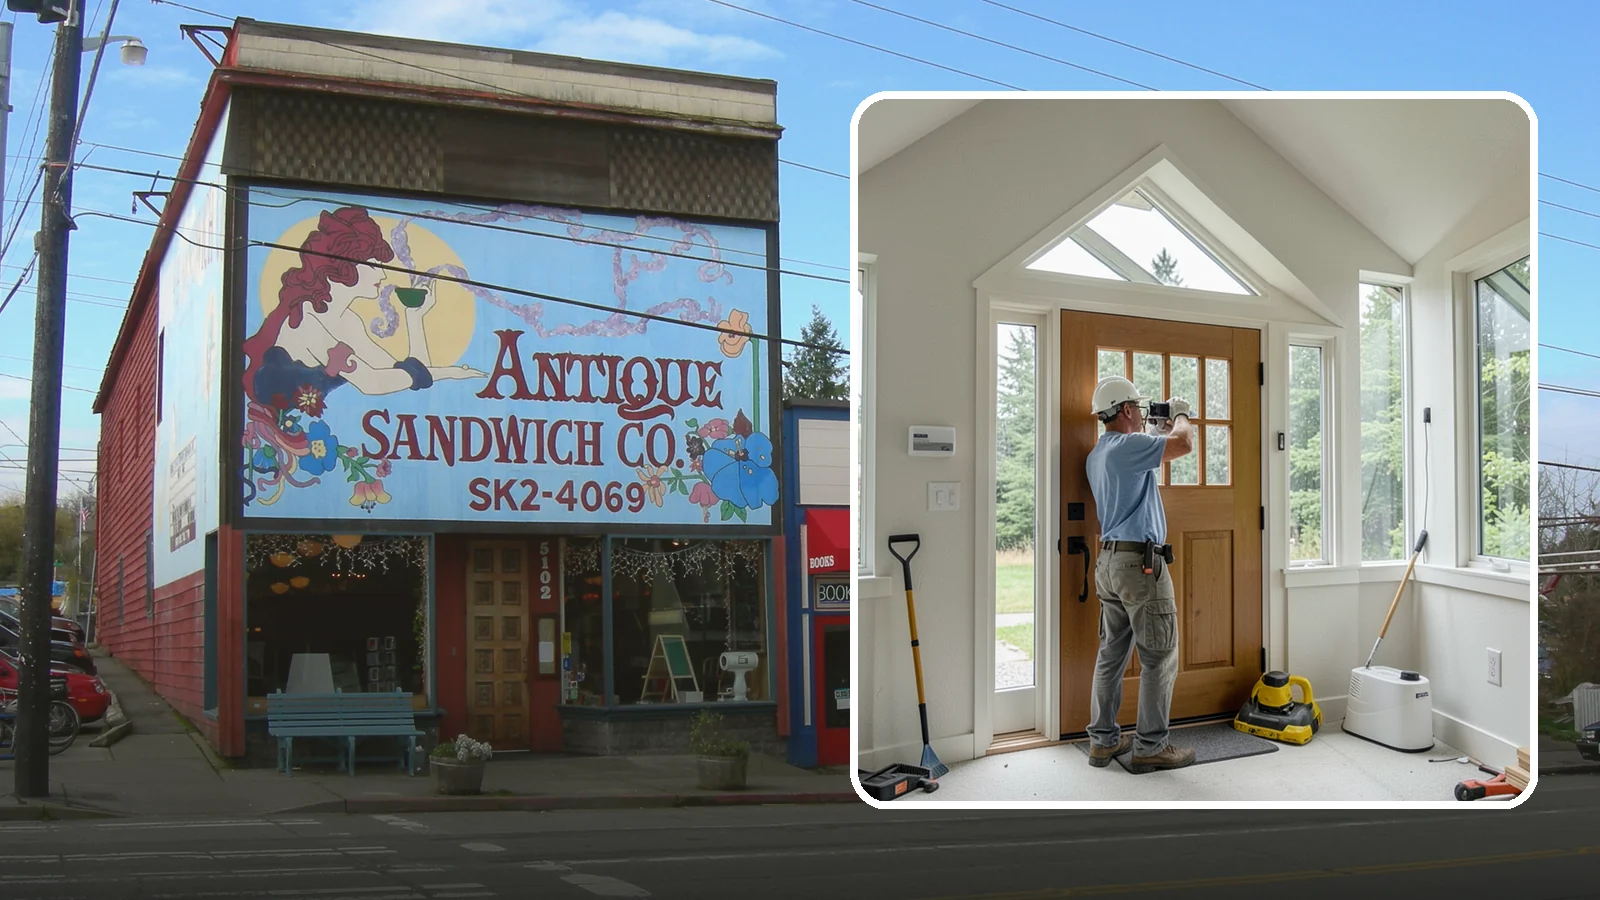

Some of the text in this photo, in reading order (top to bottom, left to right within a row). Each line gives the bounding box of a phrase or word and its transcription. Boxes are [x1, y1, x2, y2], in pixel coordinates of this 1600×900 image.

[475, 328, 723, 421] ANTIQUE
[361, 408, 685, 469] SANDWICH CO.
[468, 477, 646, 513] SK2-4069
[540, 541, 551, 600] 5102
[809, 554, 835, 569] BOOKS
